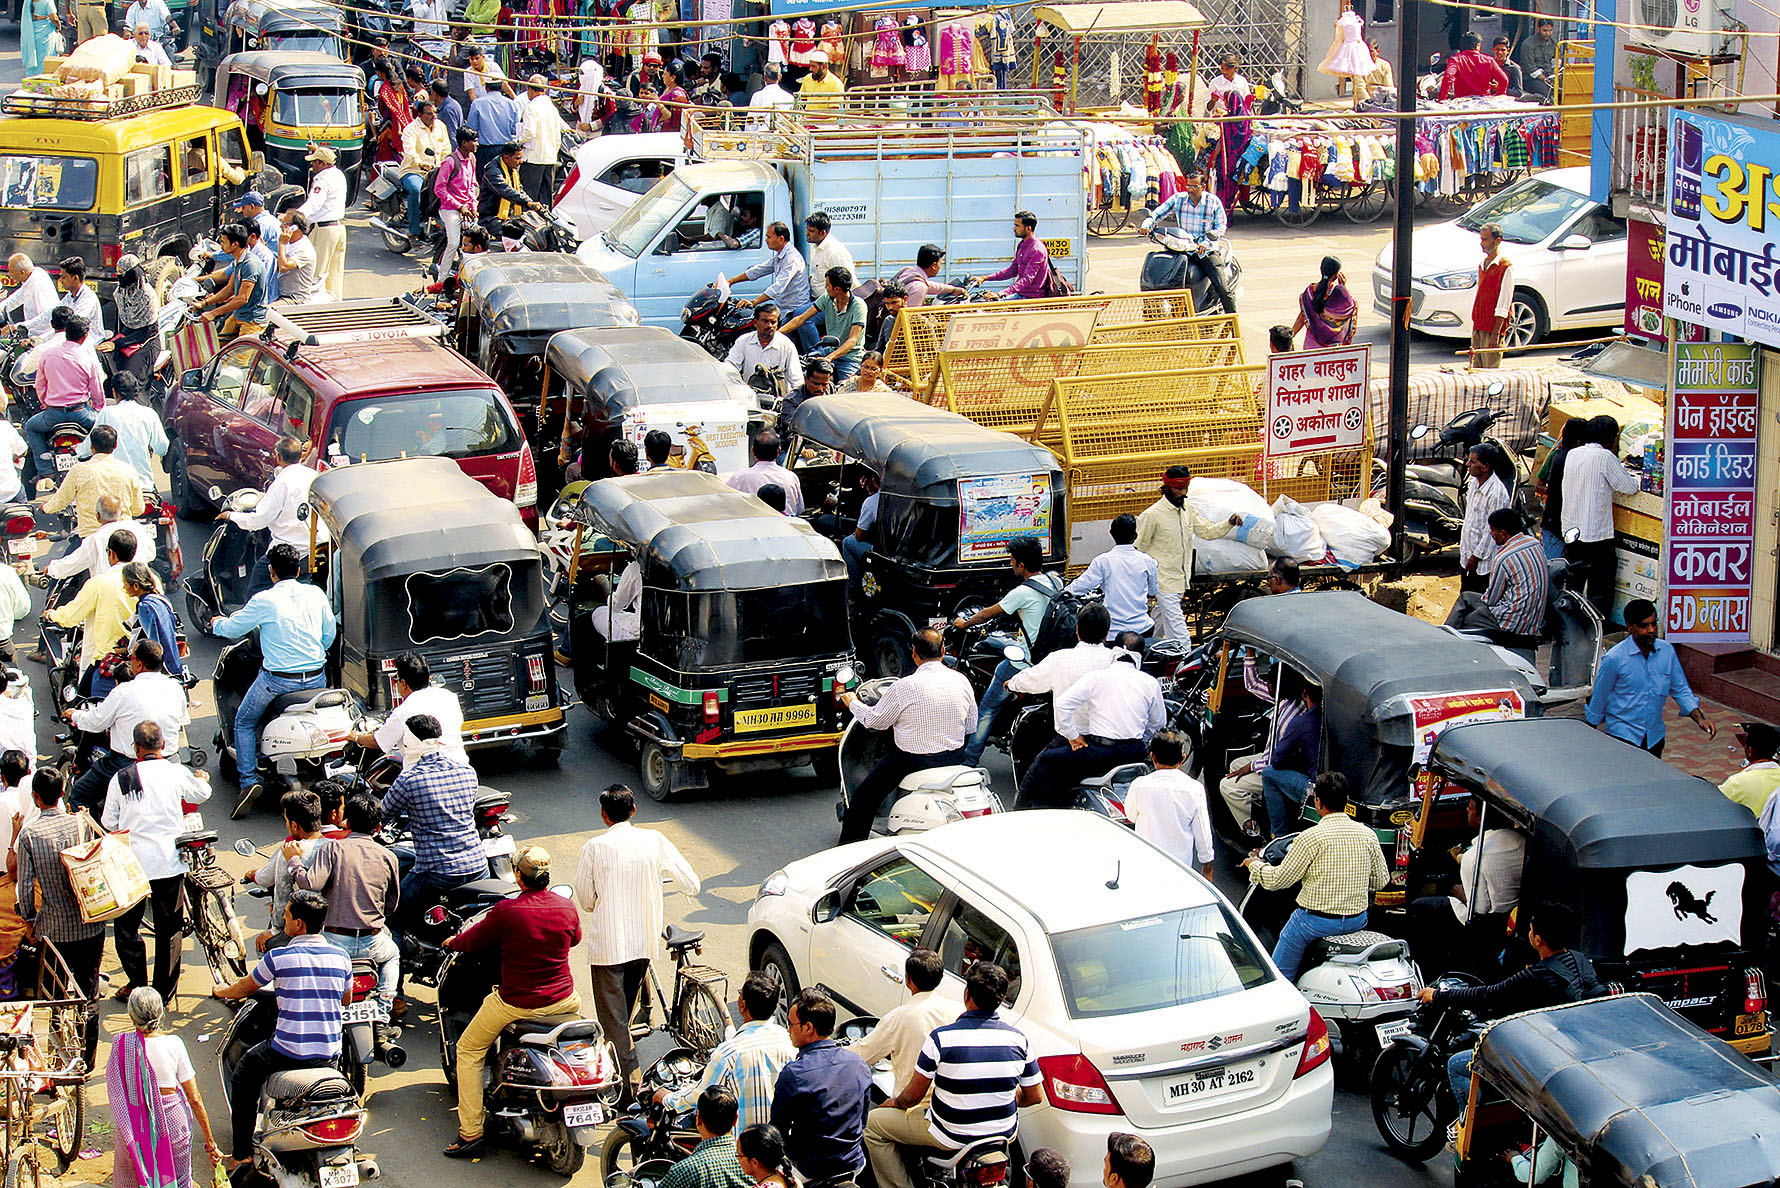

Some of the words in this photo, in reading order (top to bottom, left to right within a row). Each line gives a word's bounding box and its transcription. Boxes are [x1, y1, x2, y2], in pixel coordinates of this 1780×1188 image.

[1684, 15, 1698, 28] LG
[1668, 223, 1780, 298] मोबाई
[1635, 277, 1661, 304] पान
[1667, 292, 1702, 315] iPhone
[1711, 303, 1739, 318] SAMSUNG
[368, 329, 409, 340] TOYOTA
[1278, 363, 1307, 382] शहर
[1313, 358, 1359, 382] वाहतुक
[1678, 347, 1723, 386] मेमोरी
[1726, 347, 1757, 386] कार्ड
[1276, 384, 1326, 408] नियंत्रण
[1327, 382, 1362, 402] शाखा
[1296, 409, 1343, 432] अकोला
[1677, 395, 1706, 430] पेन
[705, 433, 720, 442] BEST
[714, 439, 739, 449] SCOOTER
[1675, 443, 1713, 480] कार्ड
[1715, 443, 1754, 480] रिडर
[1673, 493, 1752, 519] मोबाईल
[1675, 518, 1749, 535] लेमिनेशन
[1673, 543, 1750, 581] कवर
[1670, 595, 1697, 631] 5D
[1699, 596, 1749, 631] ग्लास
[742, 713, 769, 725] MH30
[785, 709, 810, 721] 9996
[1313, 992, 1339, 1002] Activa
[1663, 995, 1718, 1009] ompact
[342, 1008, 377, 1022] 3151
[1275, 1019, 1300, 1032] SWIFT
[1736, 1021, 1763, 1035] 0178
[1180, 1040, 1206, 1053] महाराष्ट्र
[1223, 1033, 1244, 1046] शासन
[1169, 1082, 1190, 1099] MH
[1190, 1079, 1206, 1094] 30
[1209, 1076, 1225, 1090] AT
[1227, 1069, 1255, 1087] 2162
[566, 1112, 602, 1126] 7645
